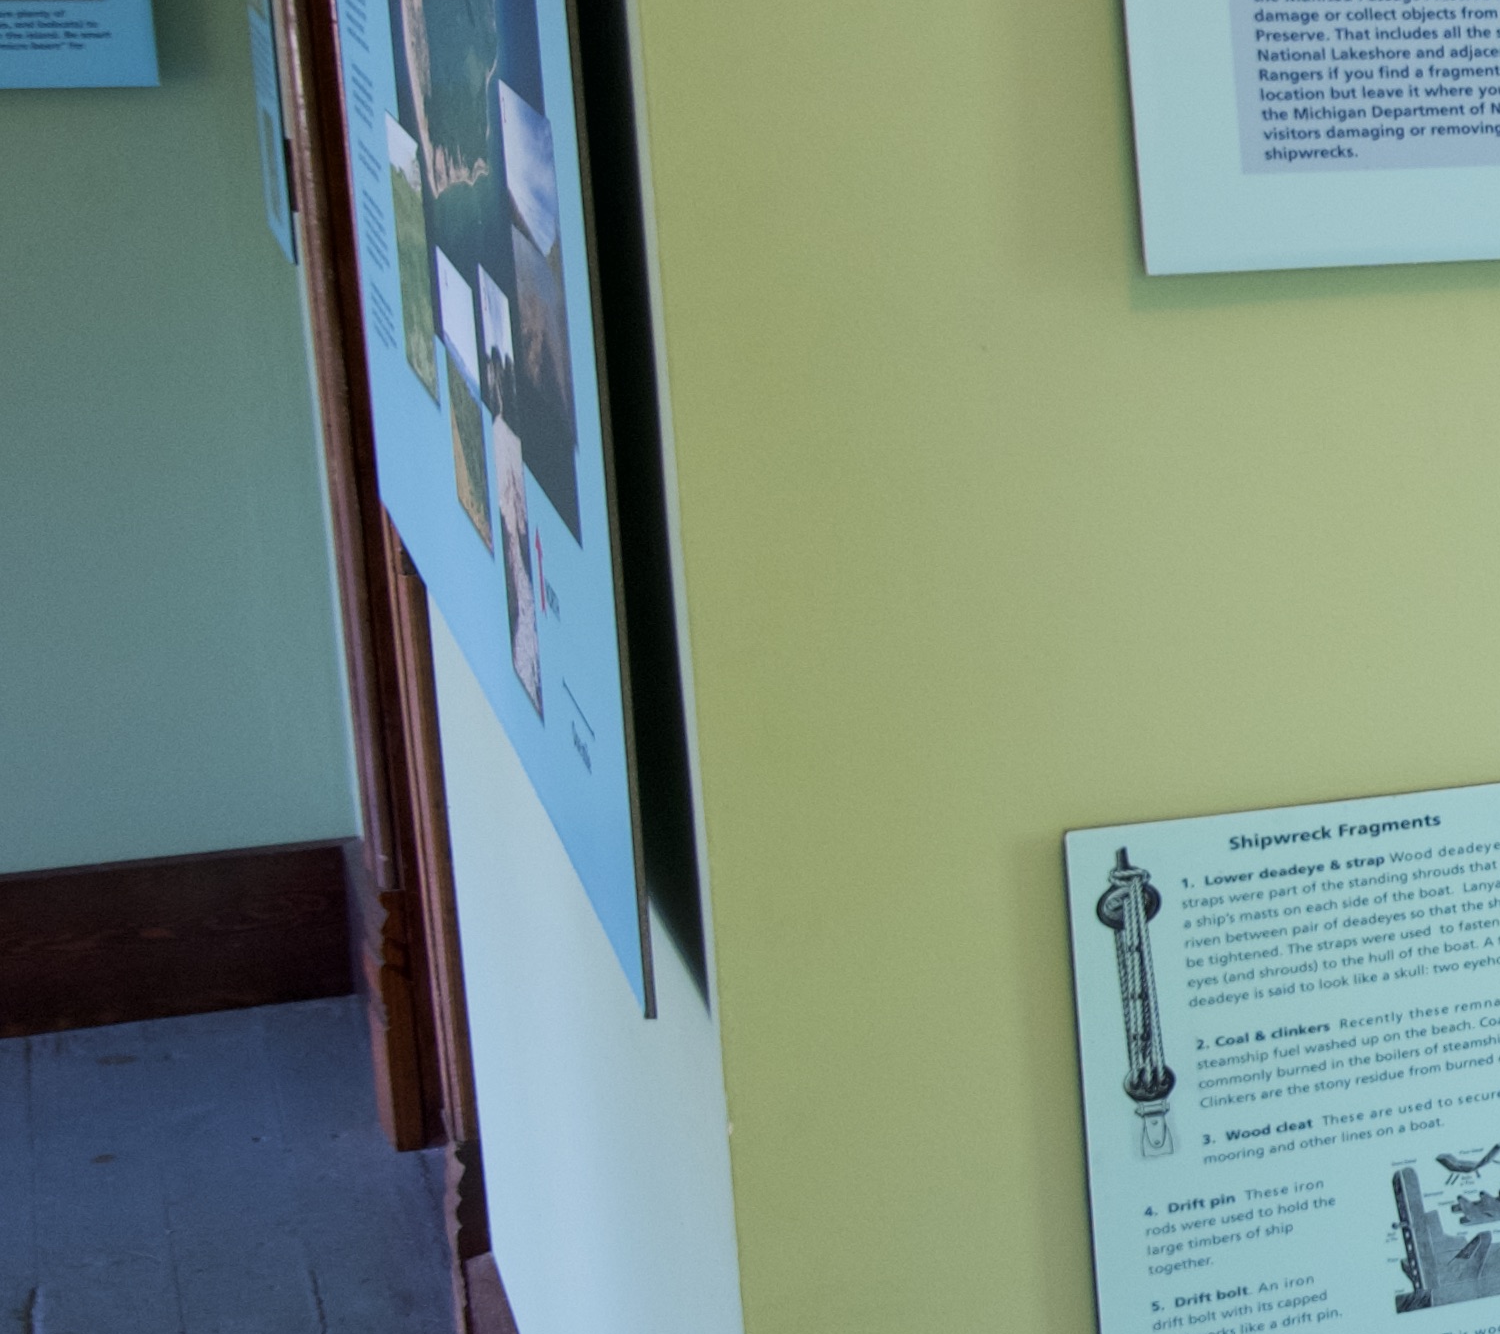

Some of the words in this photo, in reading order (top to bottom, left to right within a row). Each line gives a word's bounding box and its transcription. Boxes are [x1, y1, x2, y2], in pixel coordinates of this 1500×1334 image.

[1229, 825, 1332, 851] Shipwreck
[1338, 814, 1442, 838] Fragments
[1167, 1197, 1206, 1214] Drift
[1209, 1193, 1236, 1210] pin
[1244, 1186, 1289, 1201] These
[1294, 1180, 1324, 1193] iron
[1151, 1300, 1165, 1313] 5.
[1174, 1292, 1212, 1309] Drift
[1258, 1282, 1279, 1294] An
[1284, 1275, 1315, 1288] iron
